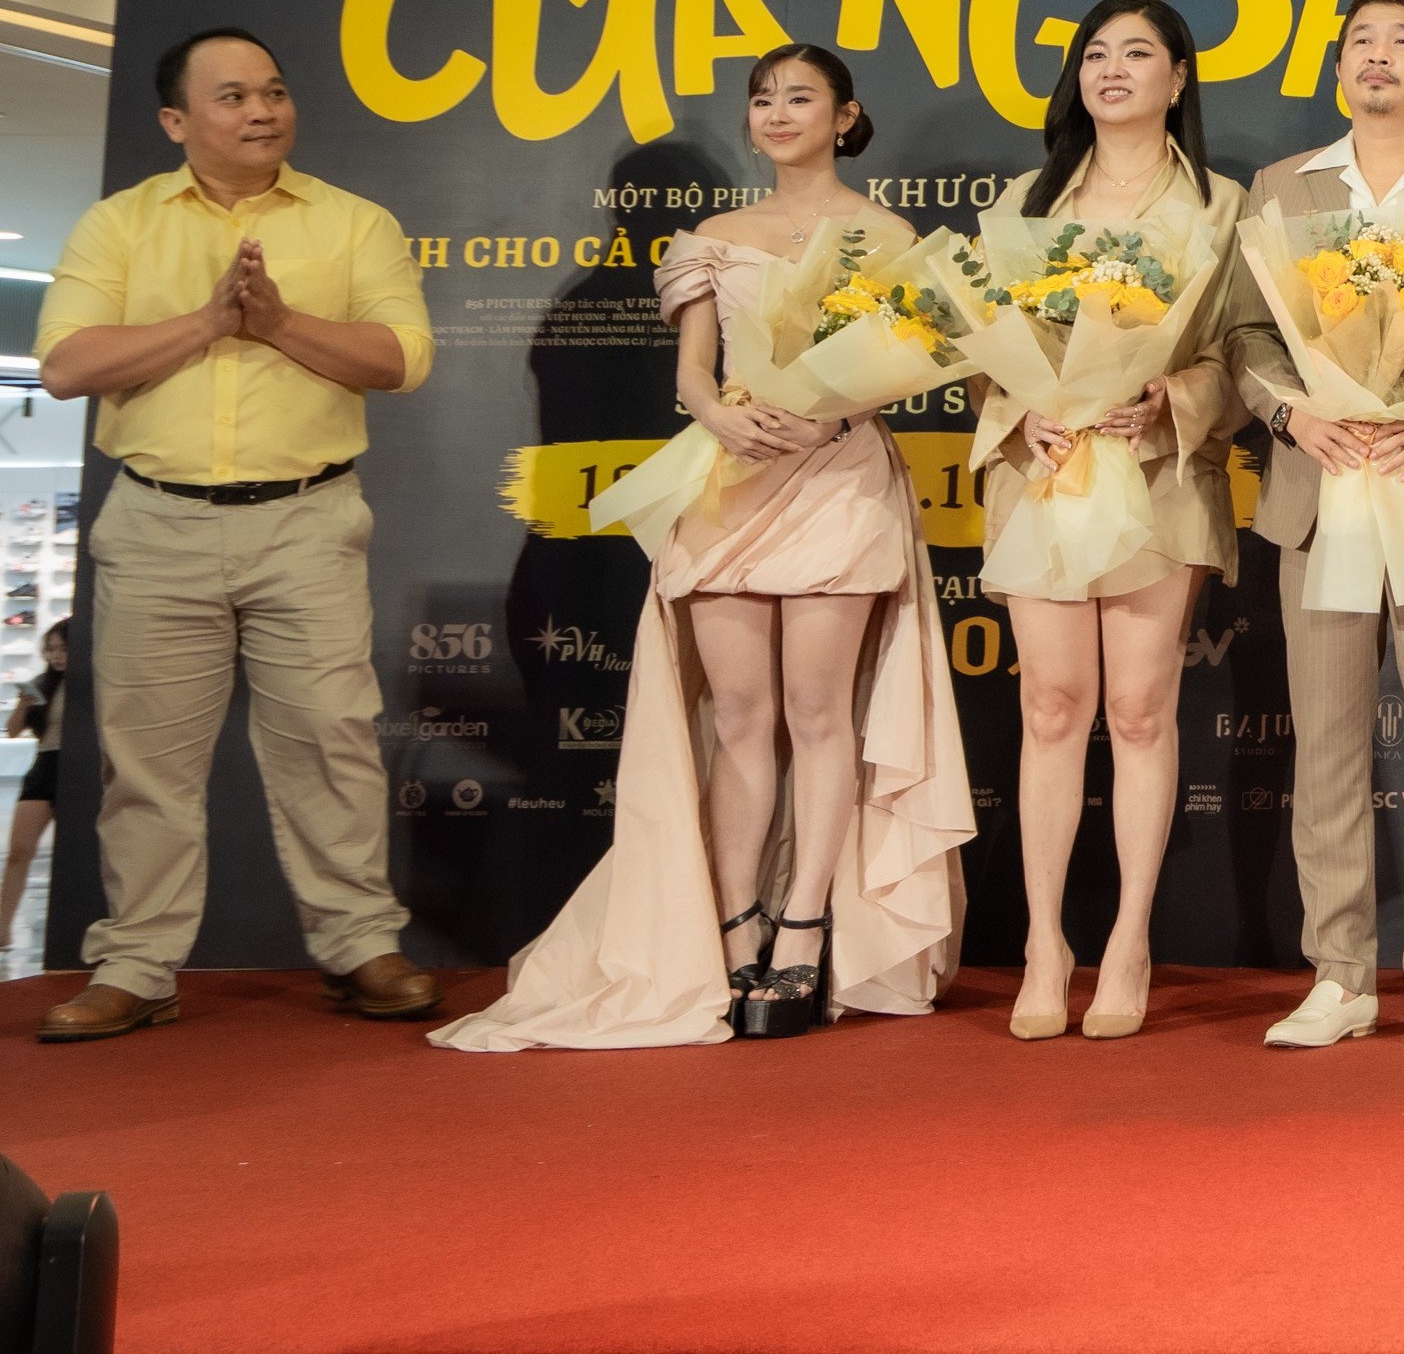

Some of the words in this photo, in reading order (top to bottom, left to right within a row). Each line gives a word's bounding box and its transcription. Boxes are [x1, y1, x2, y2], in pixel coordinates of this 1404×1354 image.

[866, 173, 1018, 208] KHƯƠ
[592, 182, 657, 214] MỘT
[666, 182, 703, 213] BỘ
[463, 236, 560, 268] CHO
[573, 227, 637, 268] CẢ
[486, 298, 552, 309] PICTURES
[596, 297, 624, 311] cùng
[550, 323, 590, 334] NGUYỄN
[409, 623, 493, 660] 856
[408, 664, 491, 674] PICTURES
[1234, 748, 1276, 756] STUDIO
[508, 797, 566, 809] #leuheu
[1202, 793, 1222, 803] khen
[1373, 792, 1398, 808] SC
[1185, 802, 1206, 813] phim
[1206, 802, 1221, 813] hay
